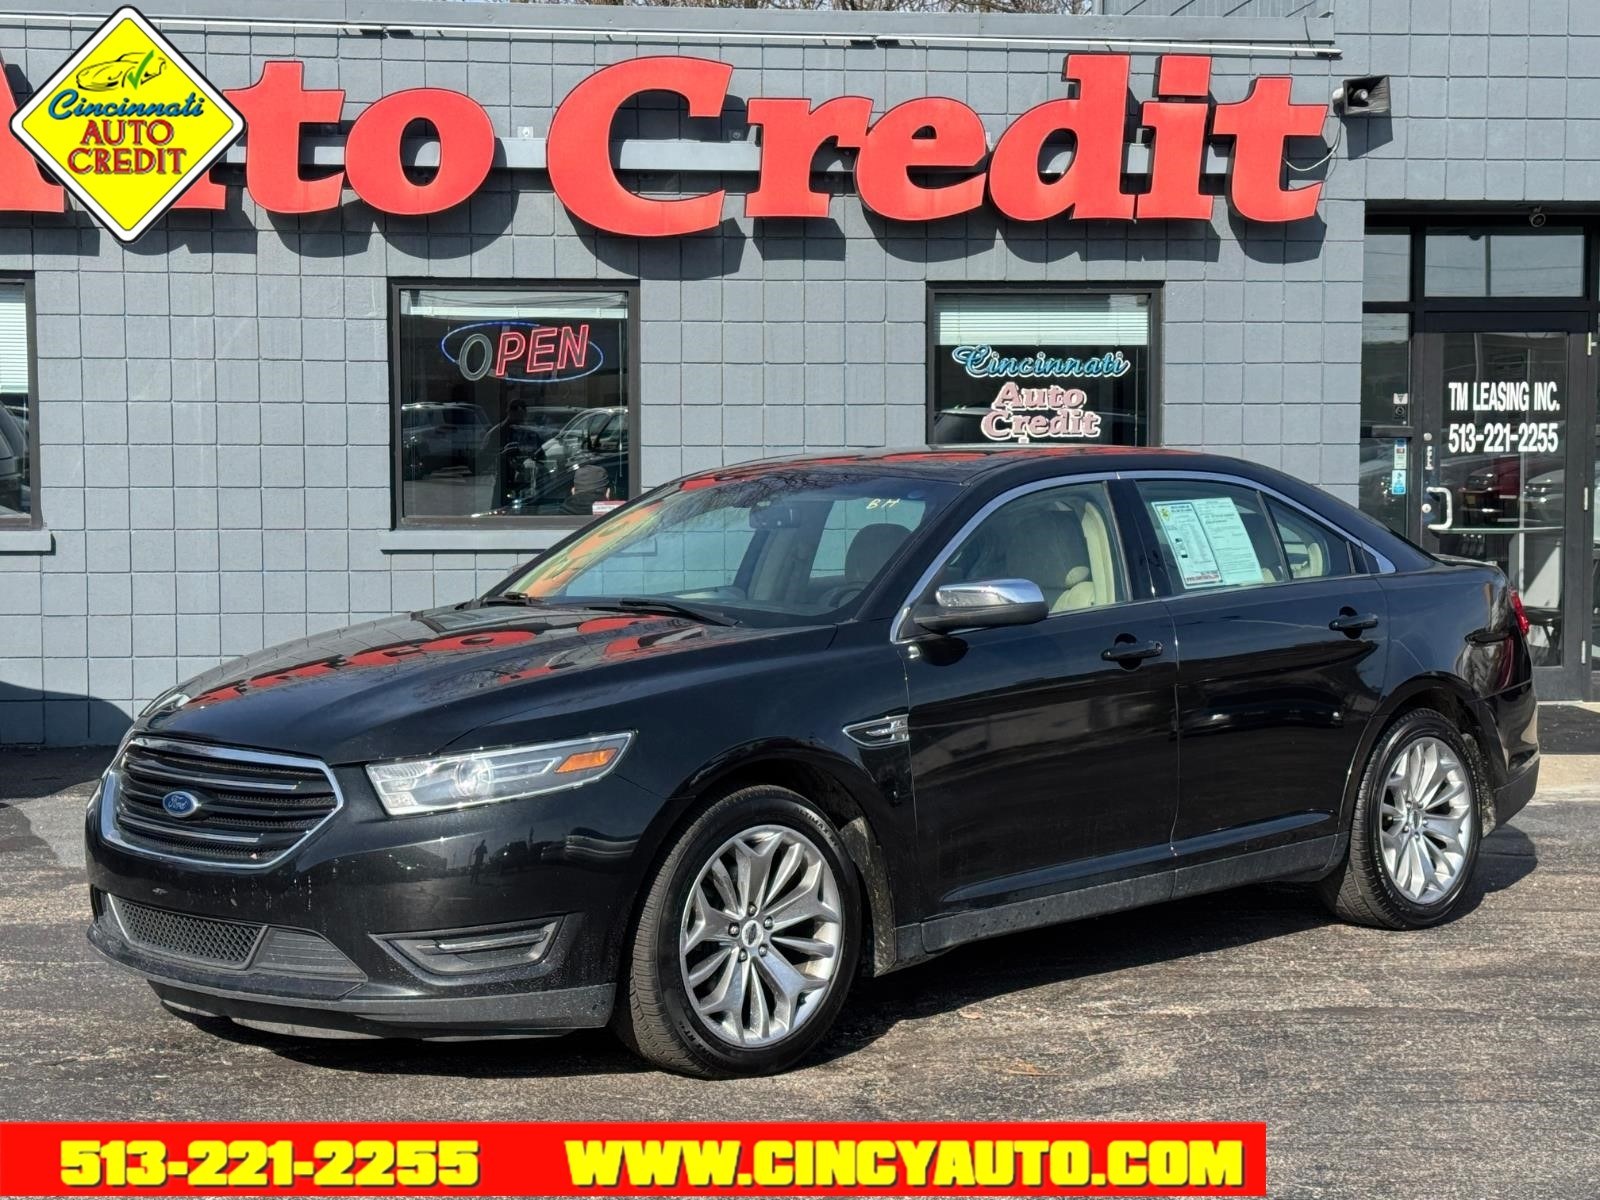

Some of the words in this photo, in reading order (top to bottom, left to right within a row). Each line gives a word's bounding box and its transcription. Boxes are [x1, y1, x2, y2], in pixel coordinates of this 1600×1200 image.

[547, 54, 1328, 237] Credit
[459, 324, 590, 381] OPEN
[952, 345, 1131, 377] Cincinnati
[992, 381, 1087, 411] Auto
[1448, 382, 1469, 411] TM
[1472, 381, 1530, 412] LEASING
[1533, 381, 1561, 412] INC.
[981, 408, 1101, 441] Credit
[1448, 422, 1559, 453] 513-221-2255
